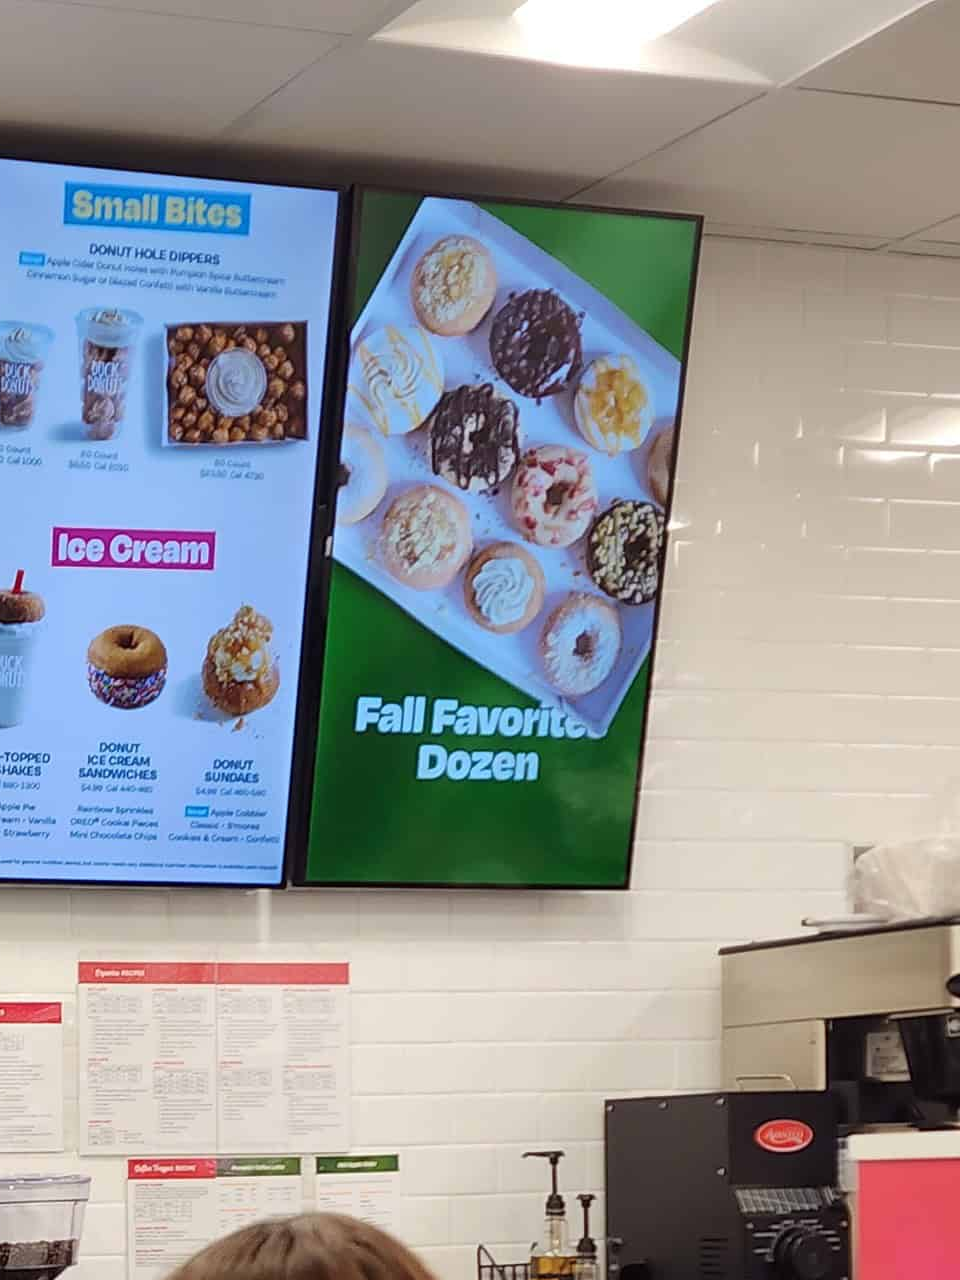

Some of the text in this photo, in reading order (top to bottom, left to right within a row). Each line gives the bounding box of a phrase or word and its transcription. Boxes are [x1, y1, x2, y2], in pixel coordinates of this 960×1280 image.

[72, 190, 243, 228] Small Bites
[89, 243, 220, 265] DONUT HOLE DIPPERS
[4, 362, 30, 380] DUCK
[91, 362, 120, 379] DUCK
[58, 533, 209, 564] Ice Cream
[355, 695, 608, 739] Fall Favorite
[99, 743, 140, 754] DONUT
[87, 755, 151, 767] ICE CREAM
[213, 760, 254, 770] DONUT
[416, 744, 539, 781] Dozen
[79, 768, 157, 780] SANDWICHES
[205, 772, 260, 783] SUNDAES
[28, 817, 56, 825] Vanilla
[4, 829, 50, 839] Strawberry
